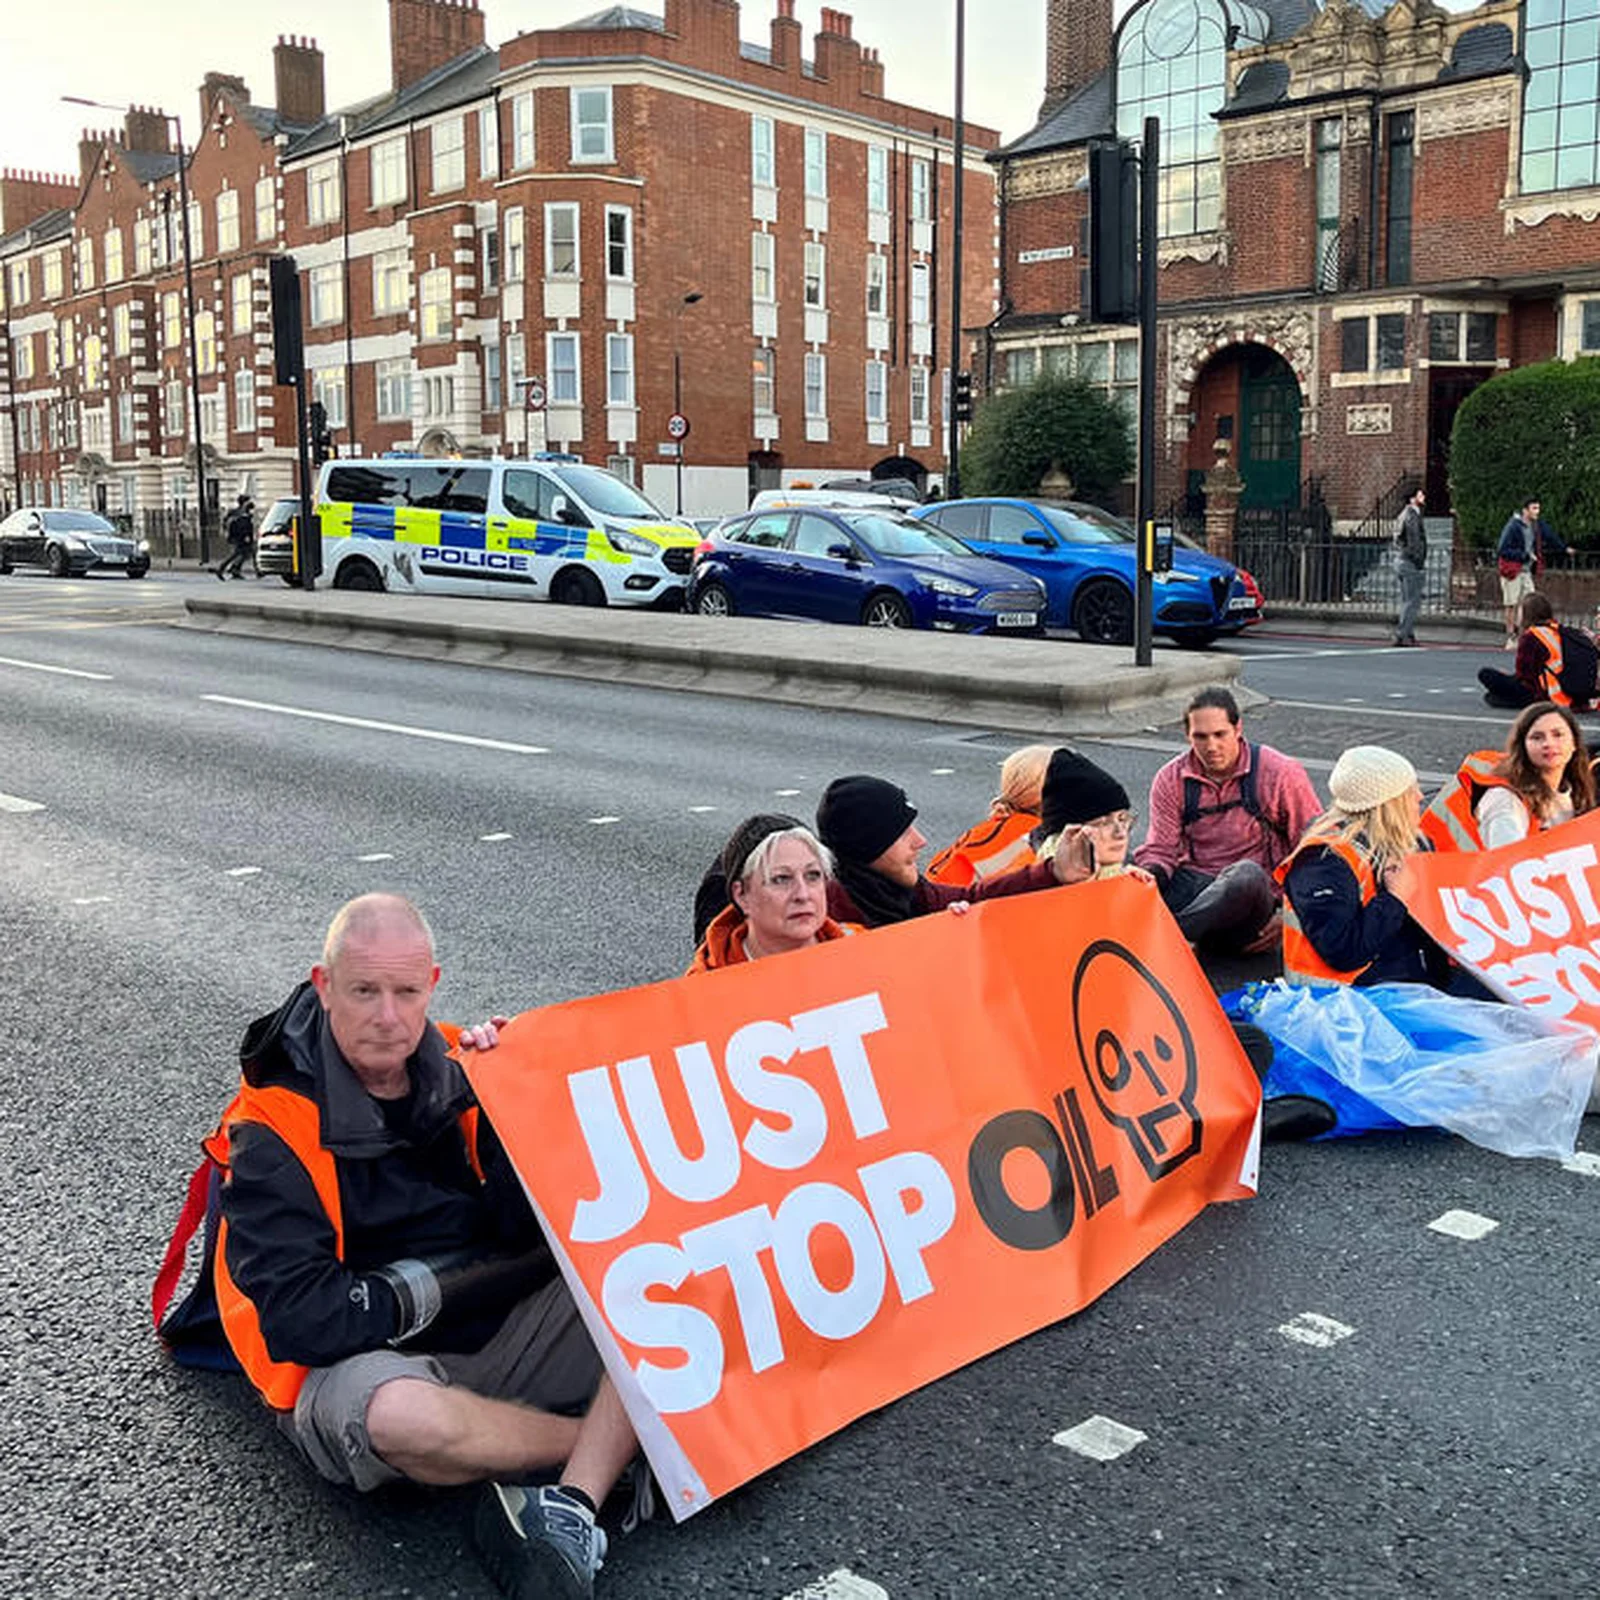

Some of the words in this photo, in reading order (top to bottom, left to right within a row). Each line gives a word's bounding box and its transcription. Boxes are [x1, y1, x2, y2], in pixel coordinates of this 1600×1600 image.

[421, 547, 528, 571] POLICE
[1438, 843, 1599, 963] JUST
[567, 992, 890, 1243] JUST
[602, 1151, 957, 1414] STOP
[967, 1086, 1121, 1252] OIL
